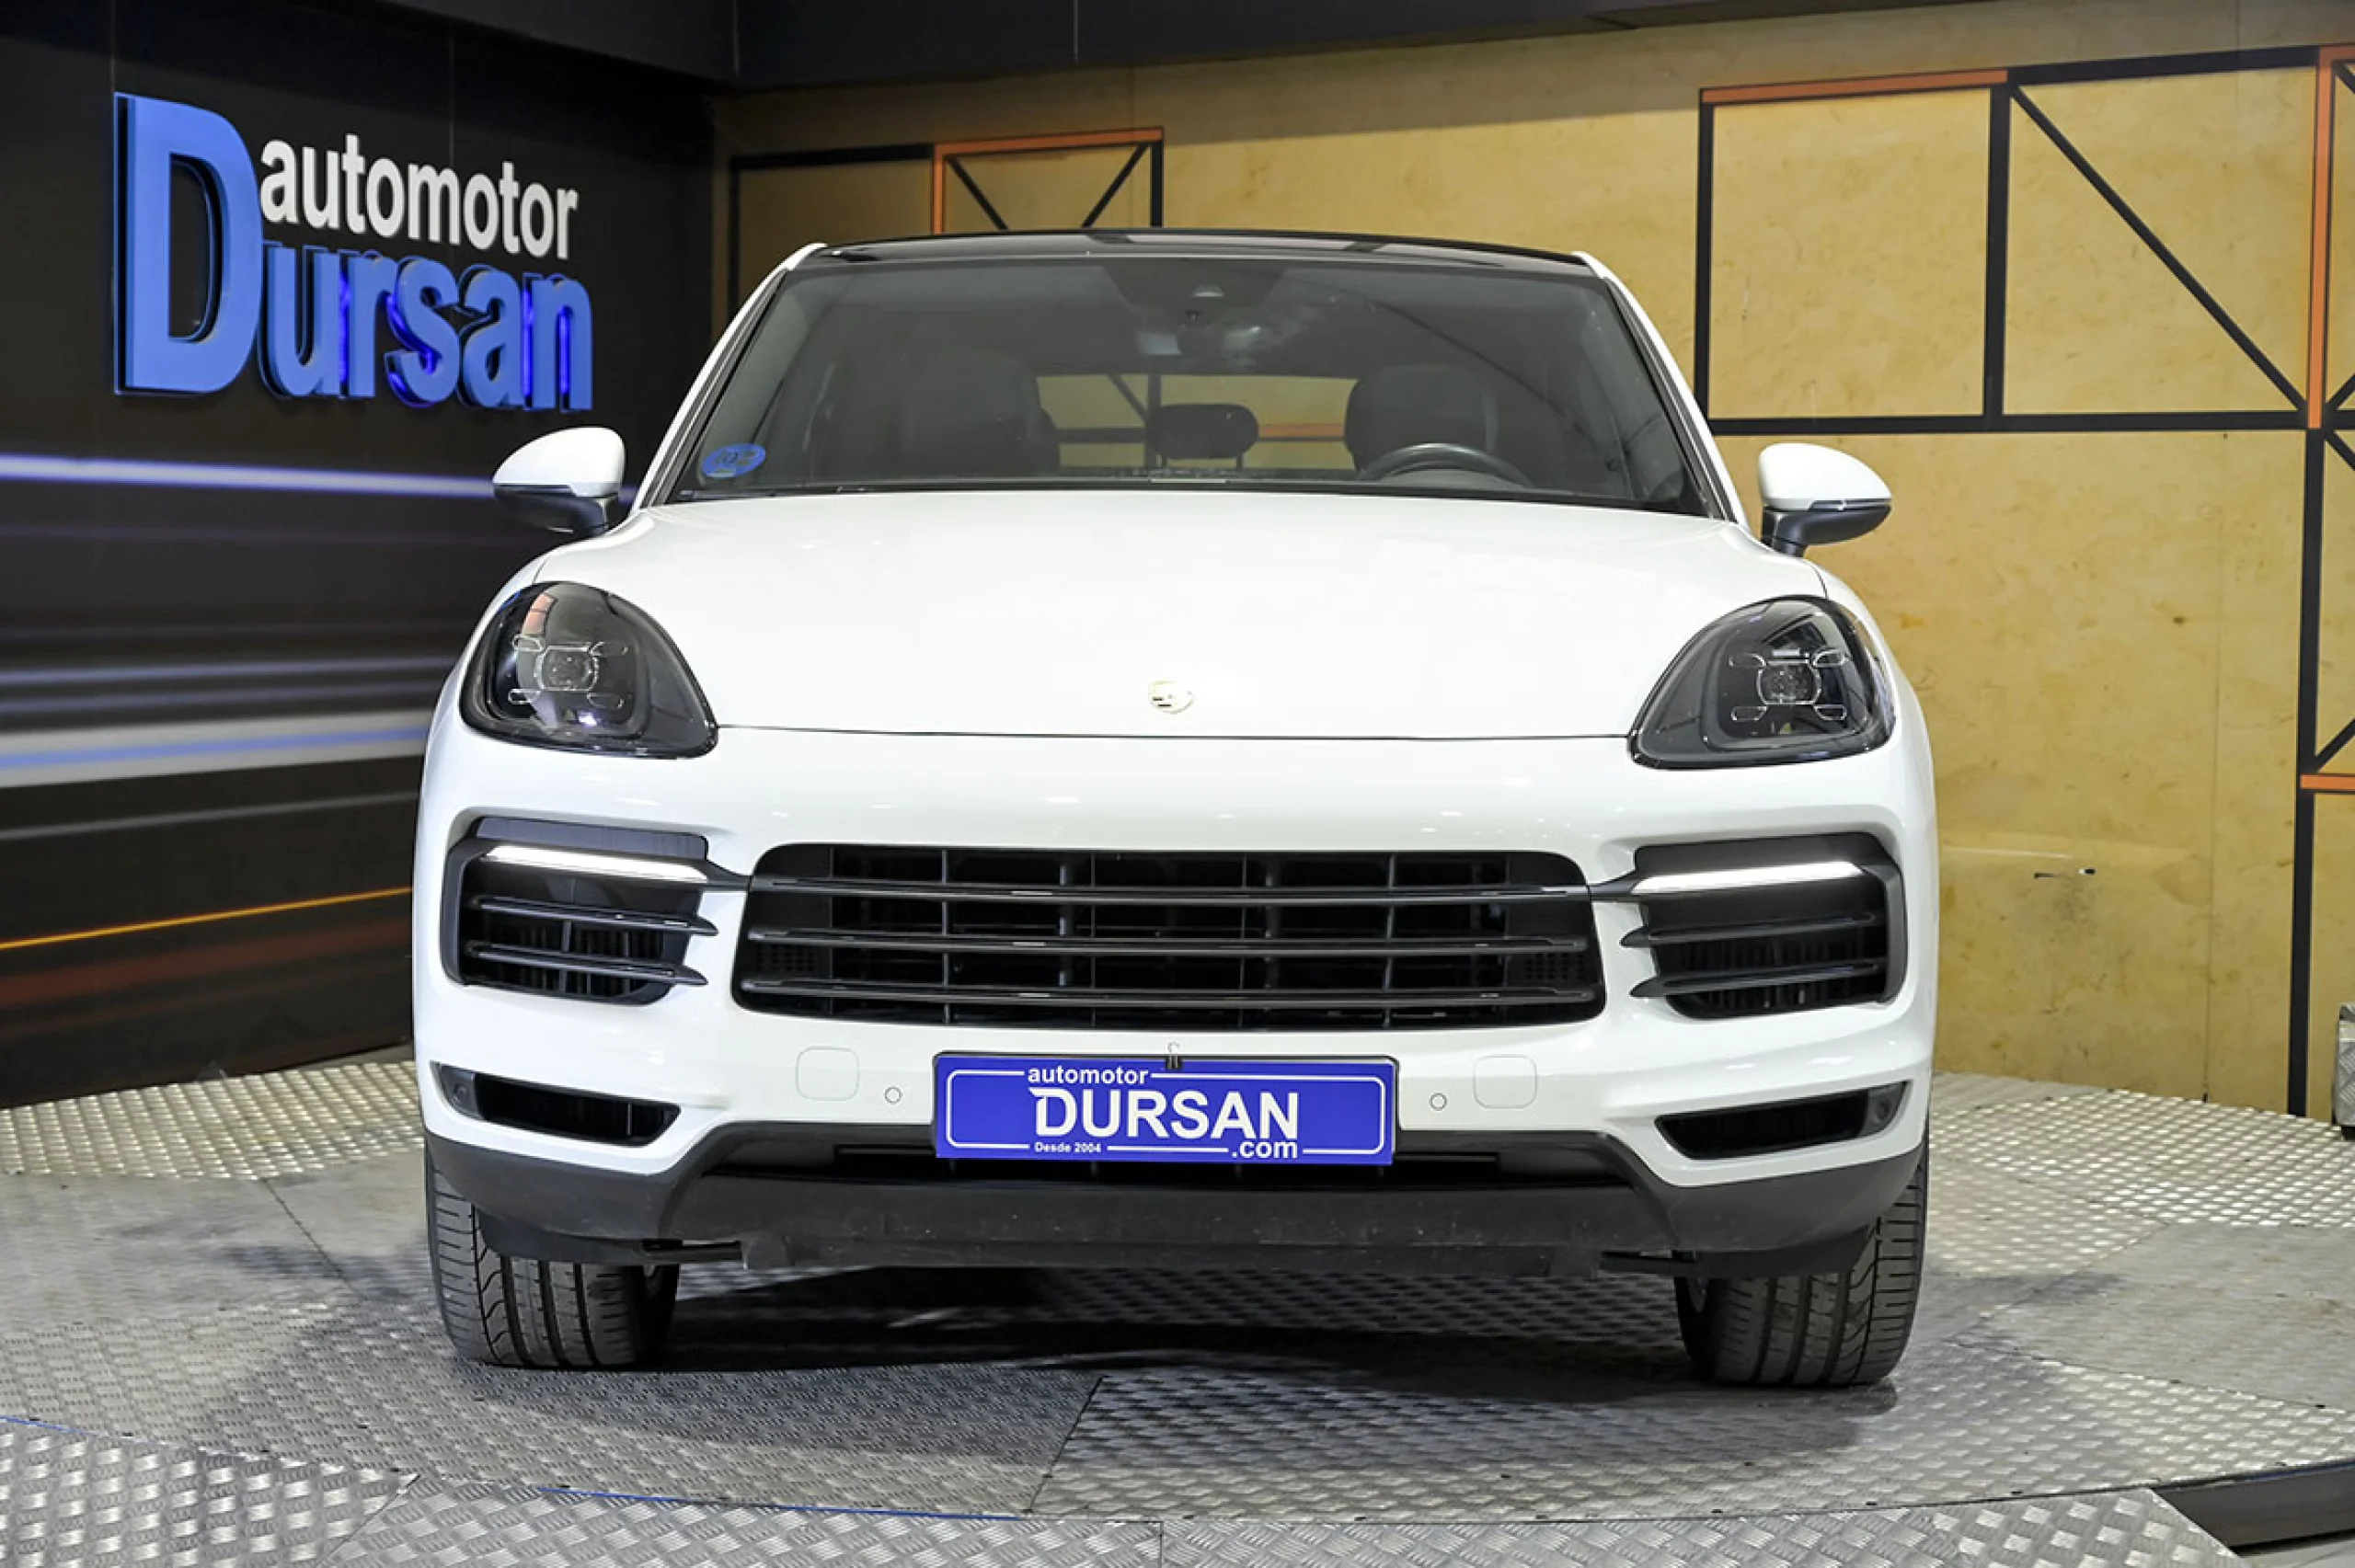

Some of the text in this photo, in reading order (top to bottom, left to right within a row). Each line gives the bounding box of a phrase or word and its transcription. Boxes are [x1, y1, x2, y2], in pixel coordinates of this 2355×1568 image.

[260, 133, 579, 259] automotor
[115, 92, 593, 412] Dursan
[1028, 1066, 1149, 1084] automotor
[1028, 1087, 1299, 1139] DURSAN
[1035, 1141, 1102, 1153] Desde 2004
[1232, 1140, 1298, 1159] .com
